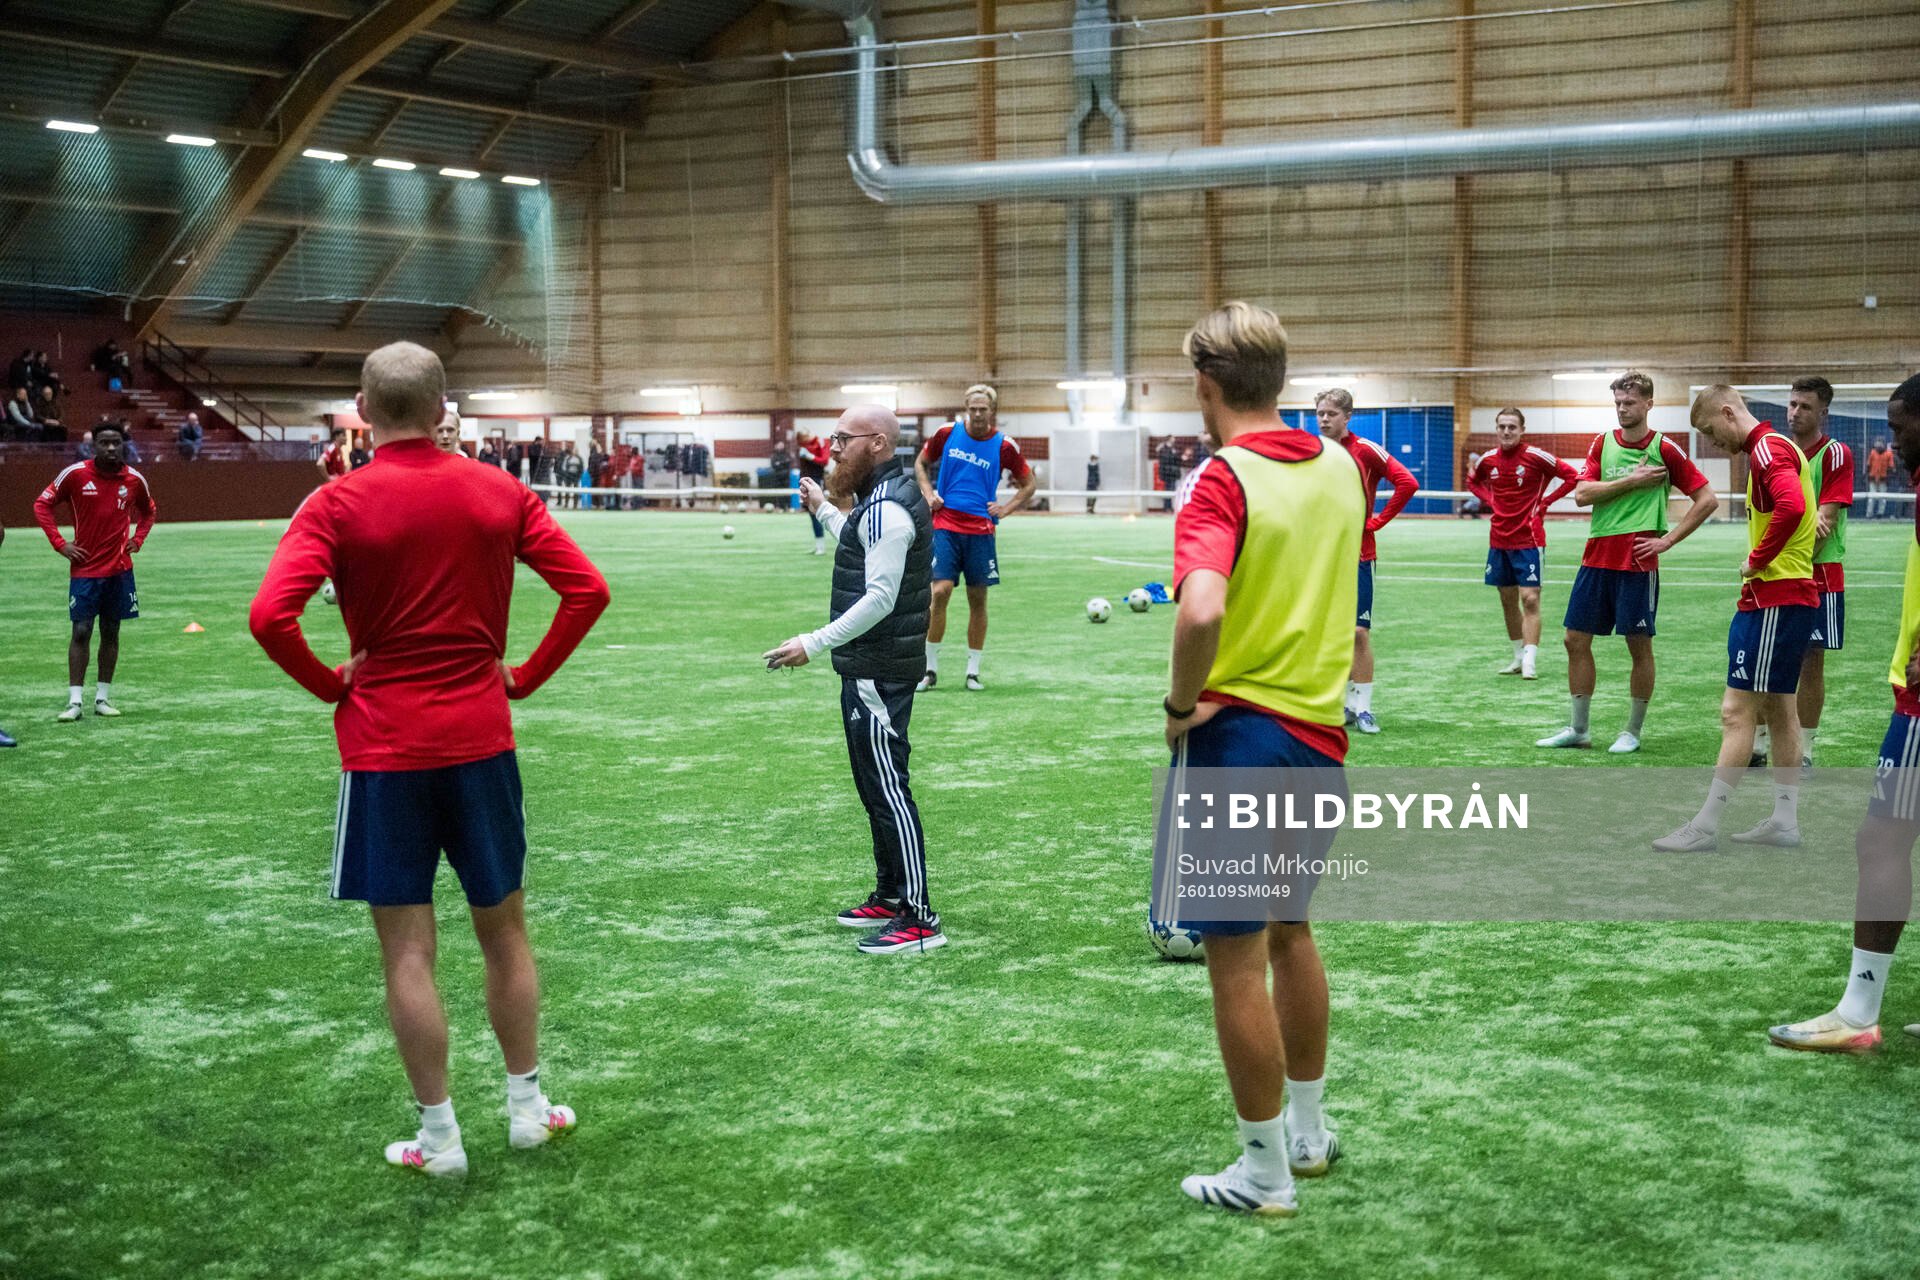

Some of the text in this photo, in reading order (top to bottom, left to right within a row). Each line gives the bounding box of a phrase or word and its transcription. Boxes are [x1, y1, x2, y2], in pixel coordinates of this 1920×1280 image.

[948, 447, 991, 471] stadium
[1516, 477, 1524, 488] 9
[988, 559, 996, 569] 5
[1529, 563, 1536, 573] 9
[1736, 649, 1746, 665] 8
